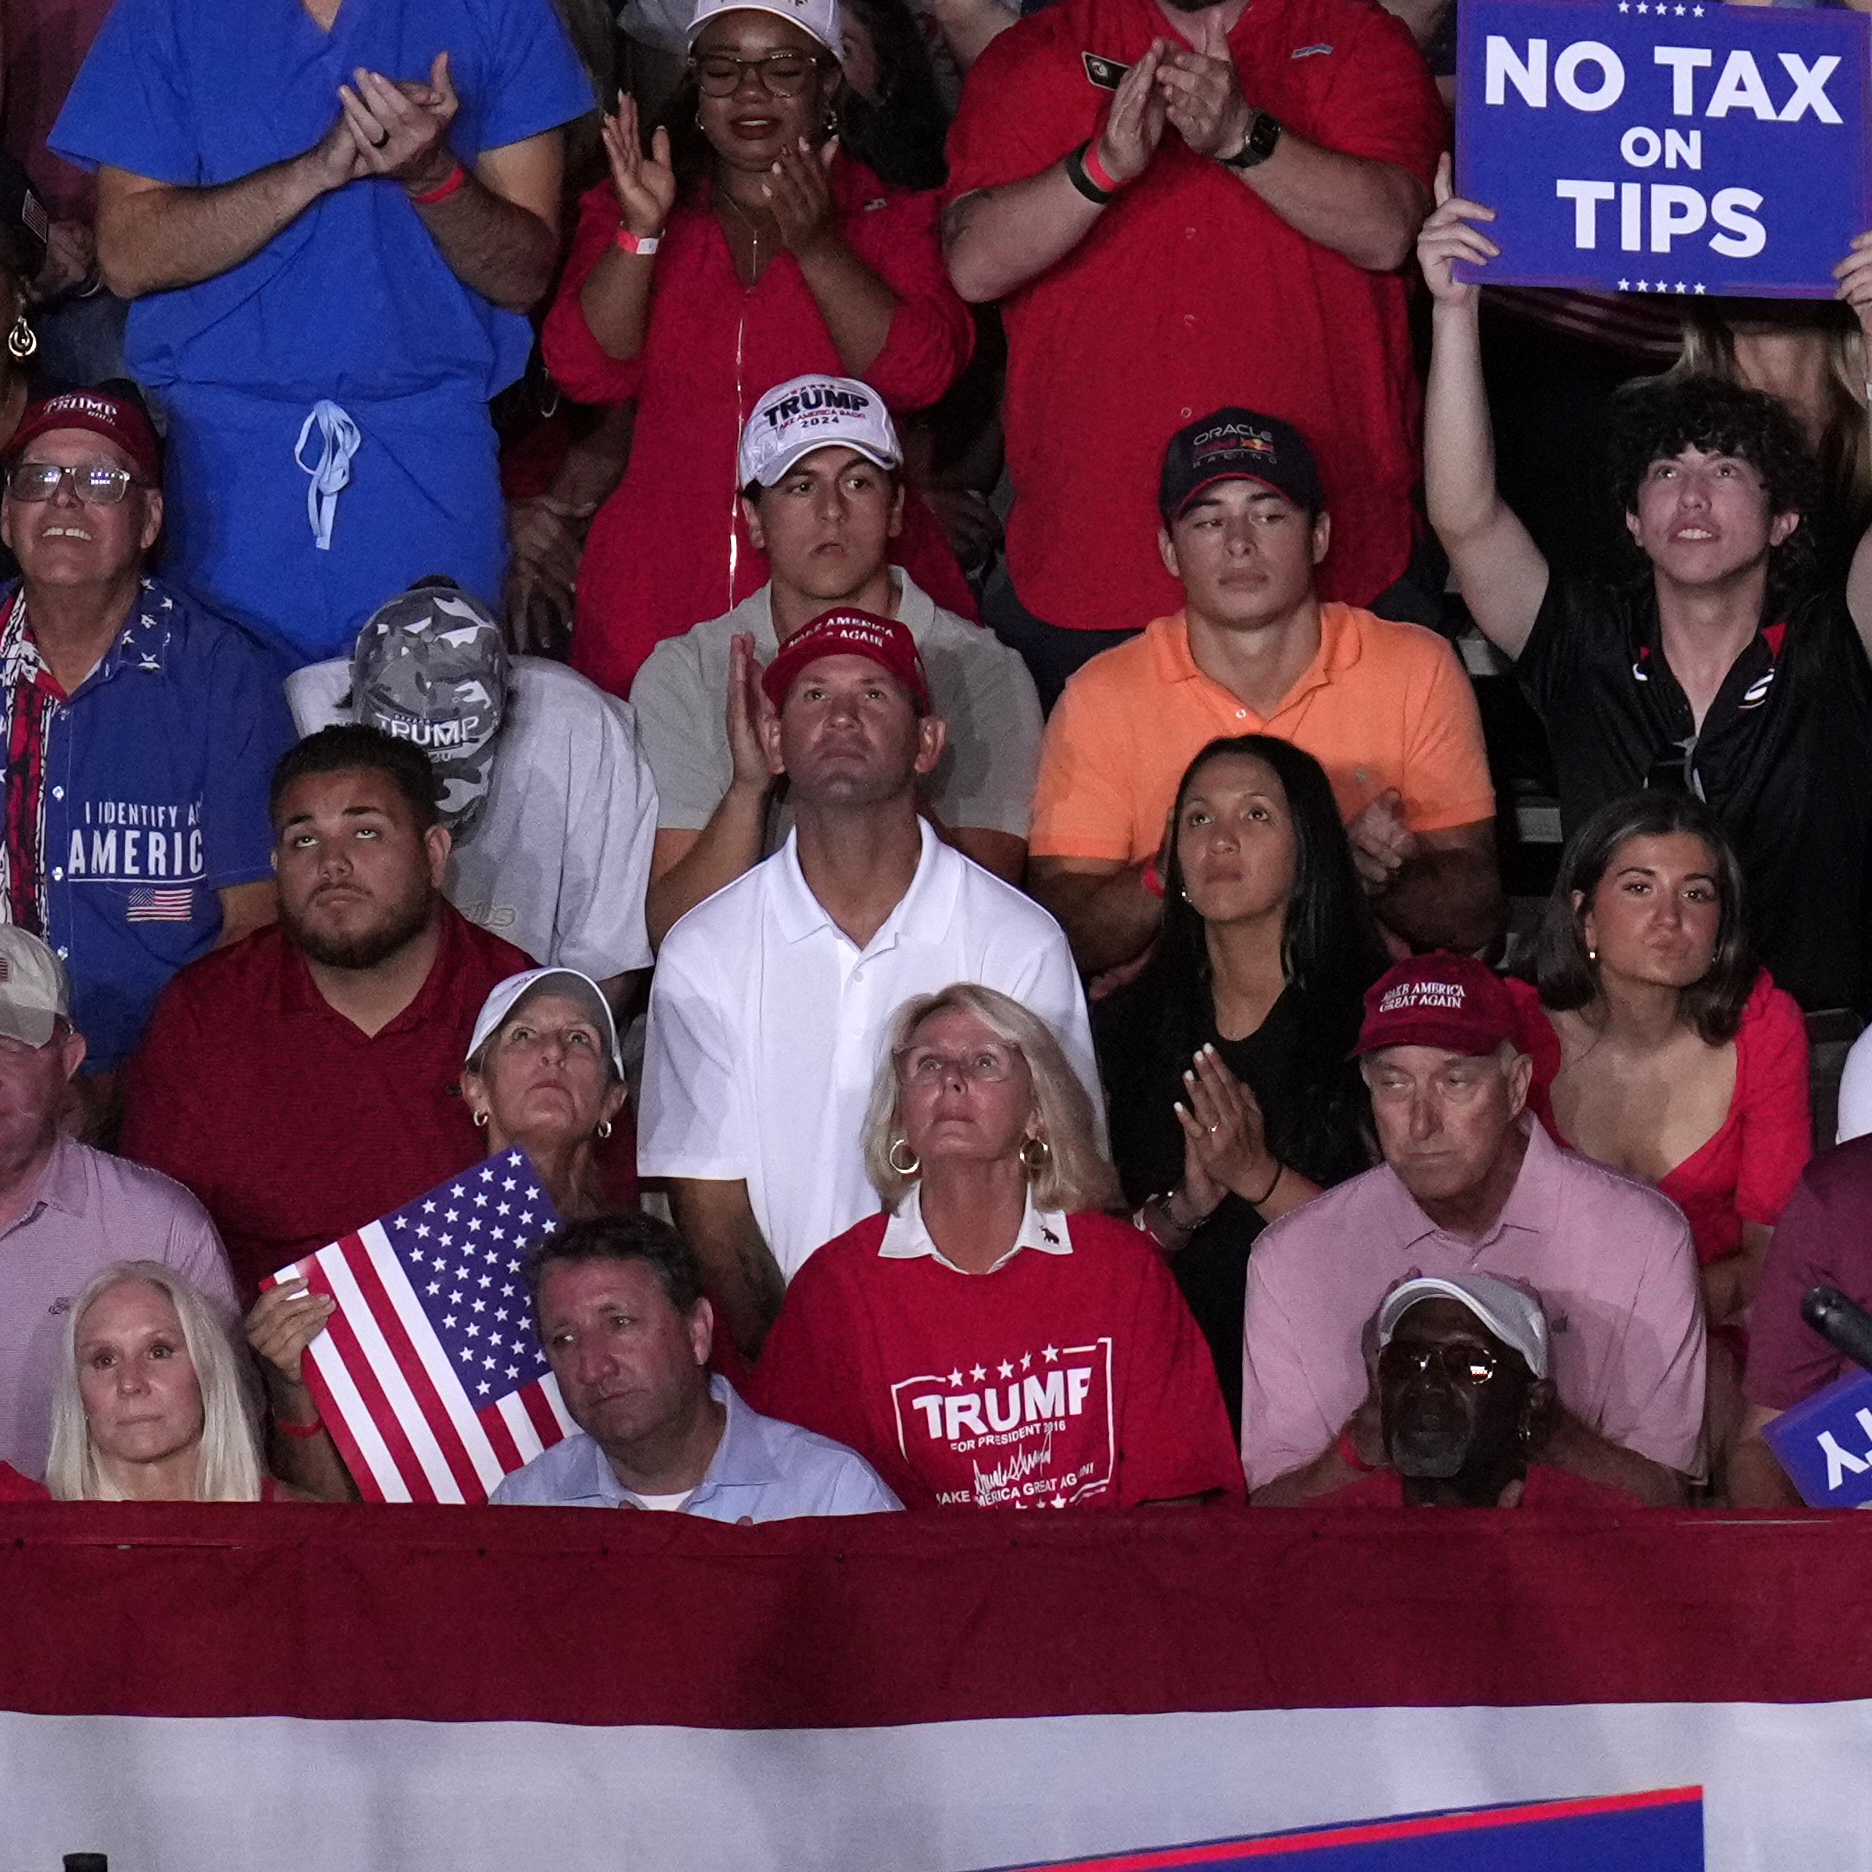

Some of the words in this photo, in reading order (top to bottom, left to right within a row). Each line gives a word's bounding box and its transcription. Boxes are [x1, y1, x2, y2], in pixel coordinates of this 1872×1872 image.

[1484, 34, 1627, 112] NO
[1653, 46, 1845, 125] TAX
[1620, 127, 1703, 170] ON
[1556, 178, 1768, 259] TIPS
[762, 390, 870, 427] TRUMP
[795, 409, 838, 422] AMERICA
[799, 417, 840, 429] 2024
[1192, 424, 1274, 445] ORACLE
[826, 616, 895, 639] AMERICA
[839, 628, 884, 647] AGAIN
[375, 711, 480, 748] TRUMP
[84, 800, 91, 825] I
[98, 801, 177, 828] IDENTIFY
[1411, 981, 1466, 999] AMERICA
[1380, 995, 1418, 1013] GREAT
[1419, 994, 1462, 1010] AGAIN
[950, 1438, 976, 1453] FOR
[977, 1424, 1043, 1449] PRESIDENT
[1022, 1477, 1058, 1496] GREAT
